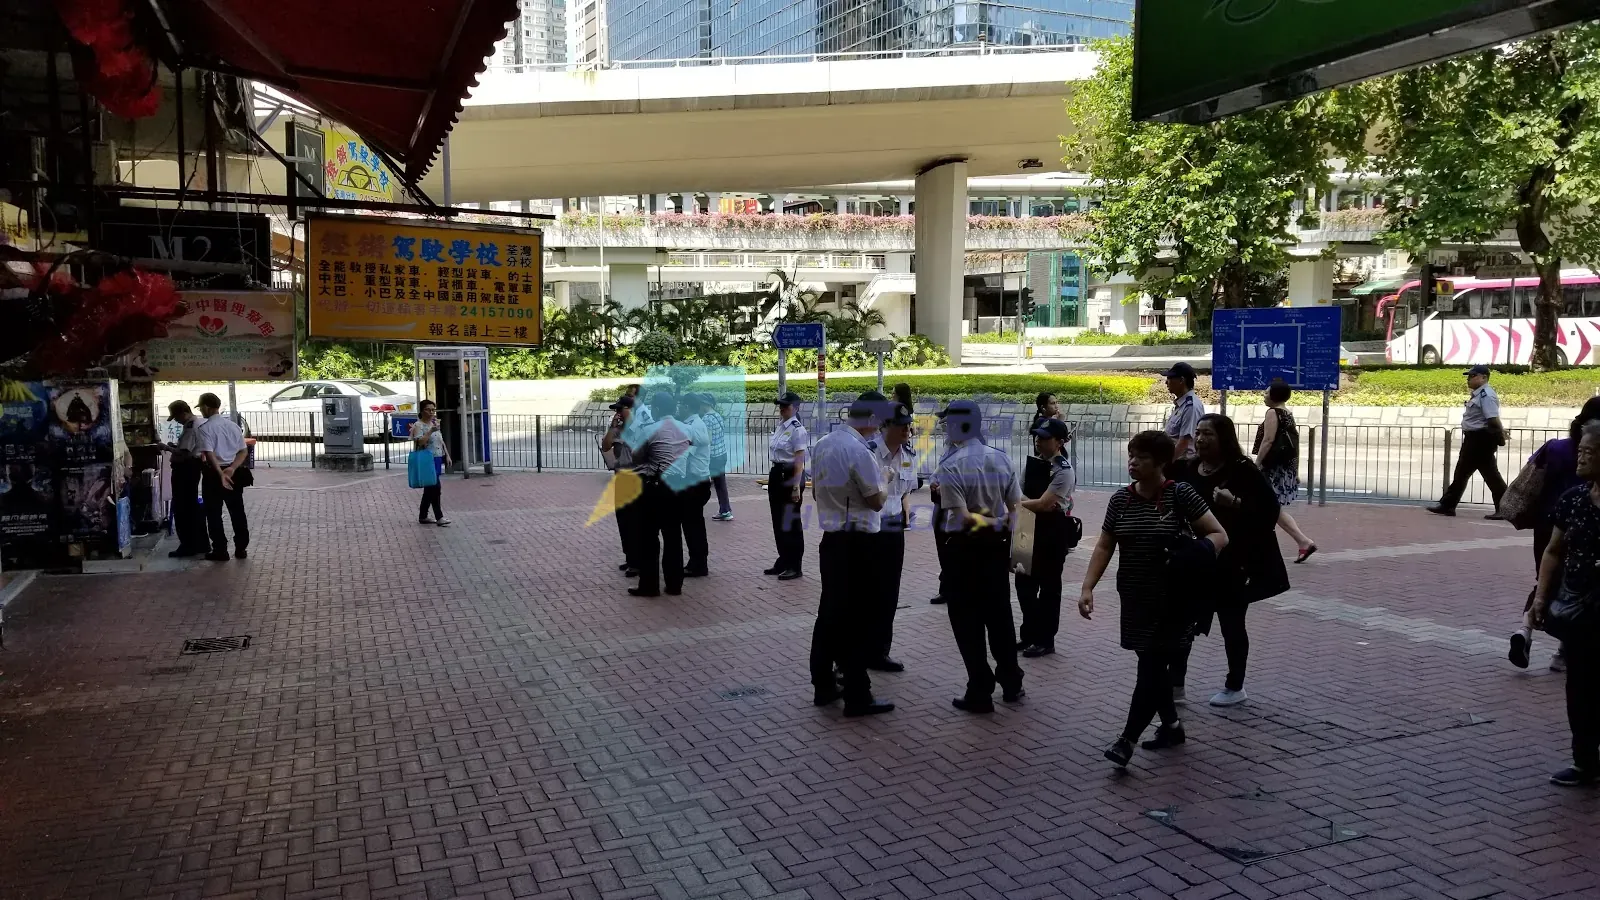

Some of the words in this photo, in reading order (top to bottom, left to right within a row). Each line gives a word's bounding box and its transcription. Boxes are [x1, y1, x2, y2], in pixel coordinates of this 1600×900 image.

[147, 235, 213, 262] M2
[506, 244, 532, 257] 荃灣
[506, 256, 532, 269] 分校
[460, 305, 534, 320] 24157090
[429, 322, 528, 339] 報名請上三樓
